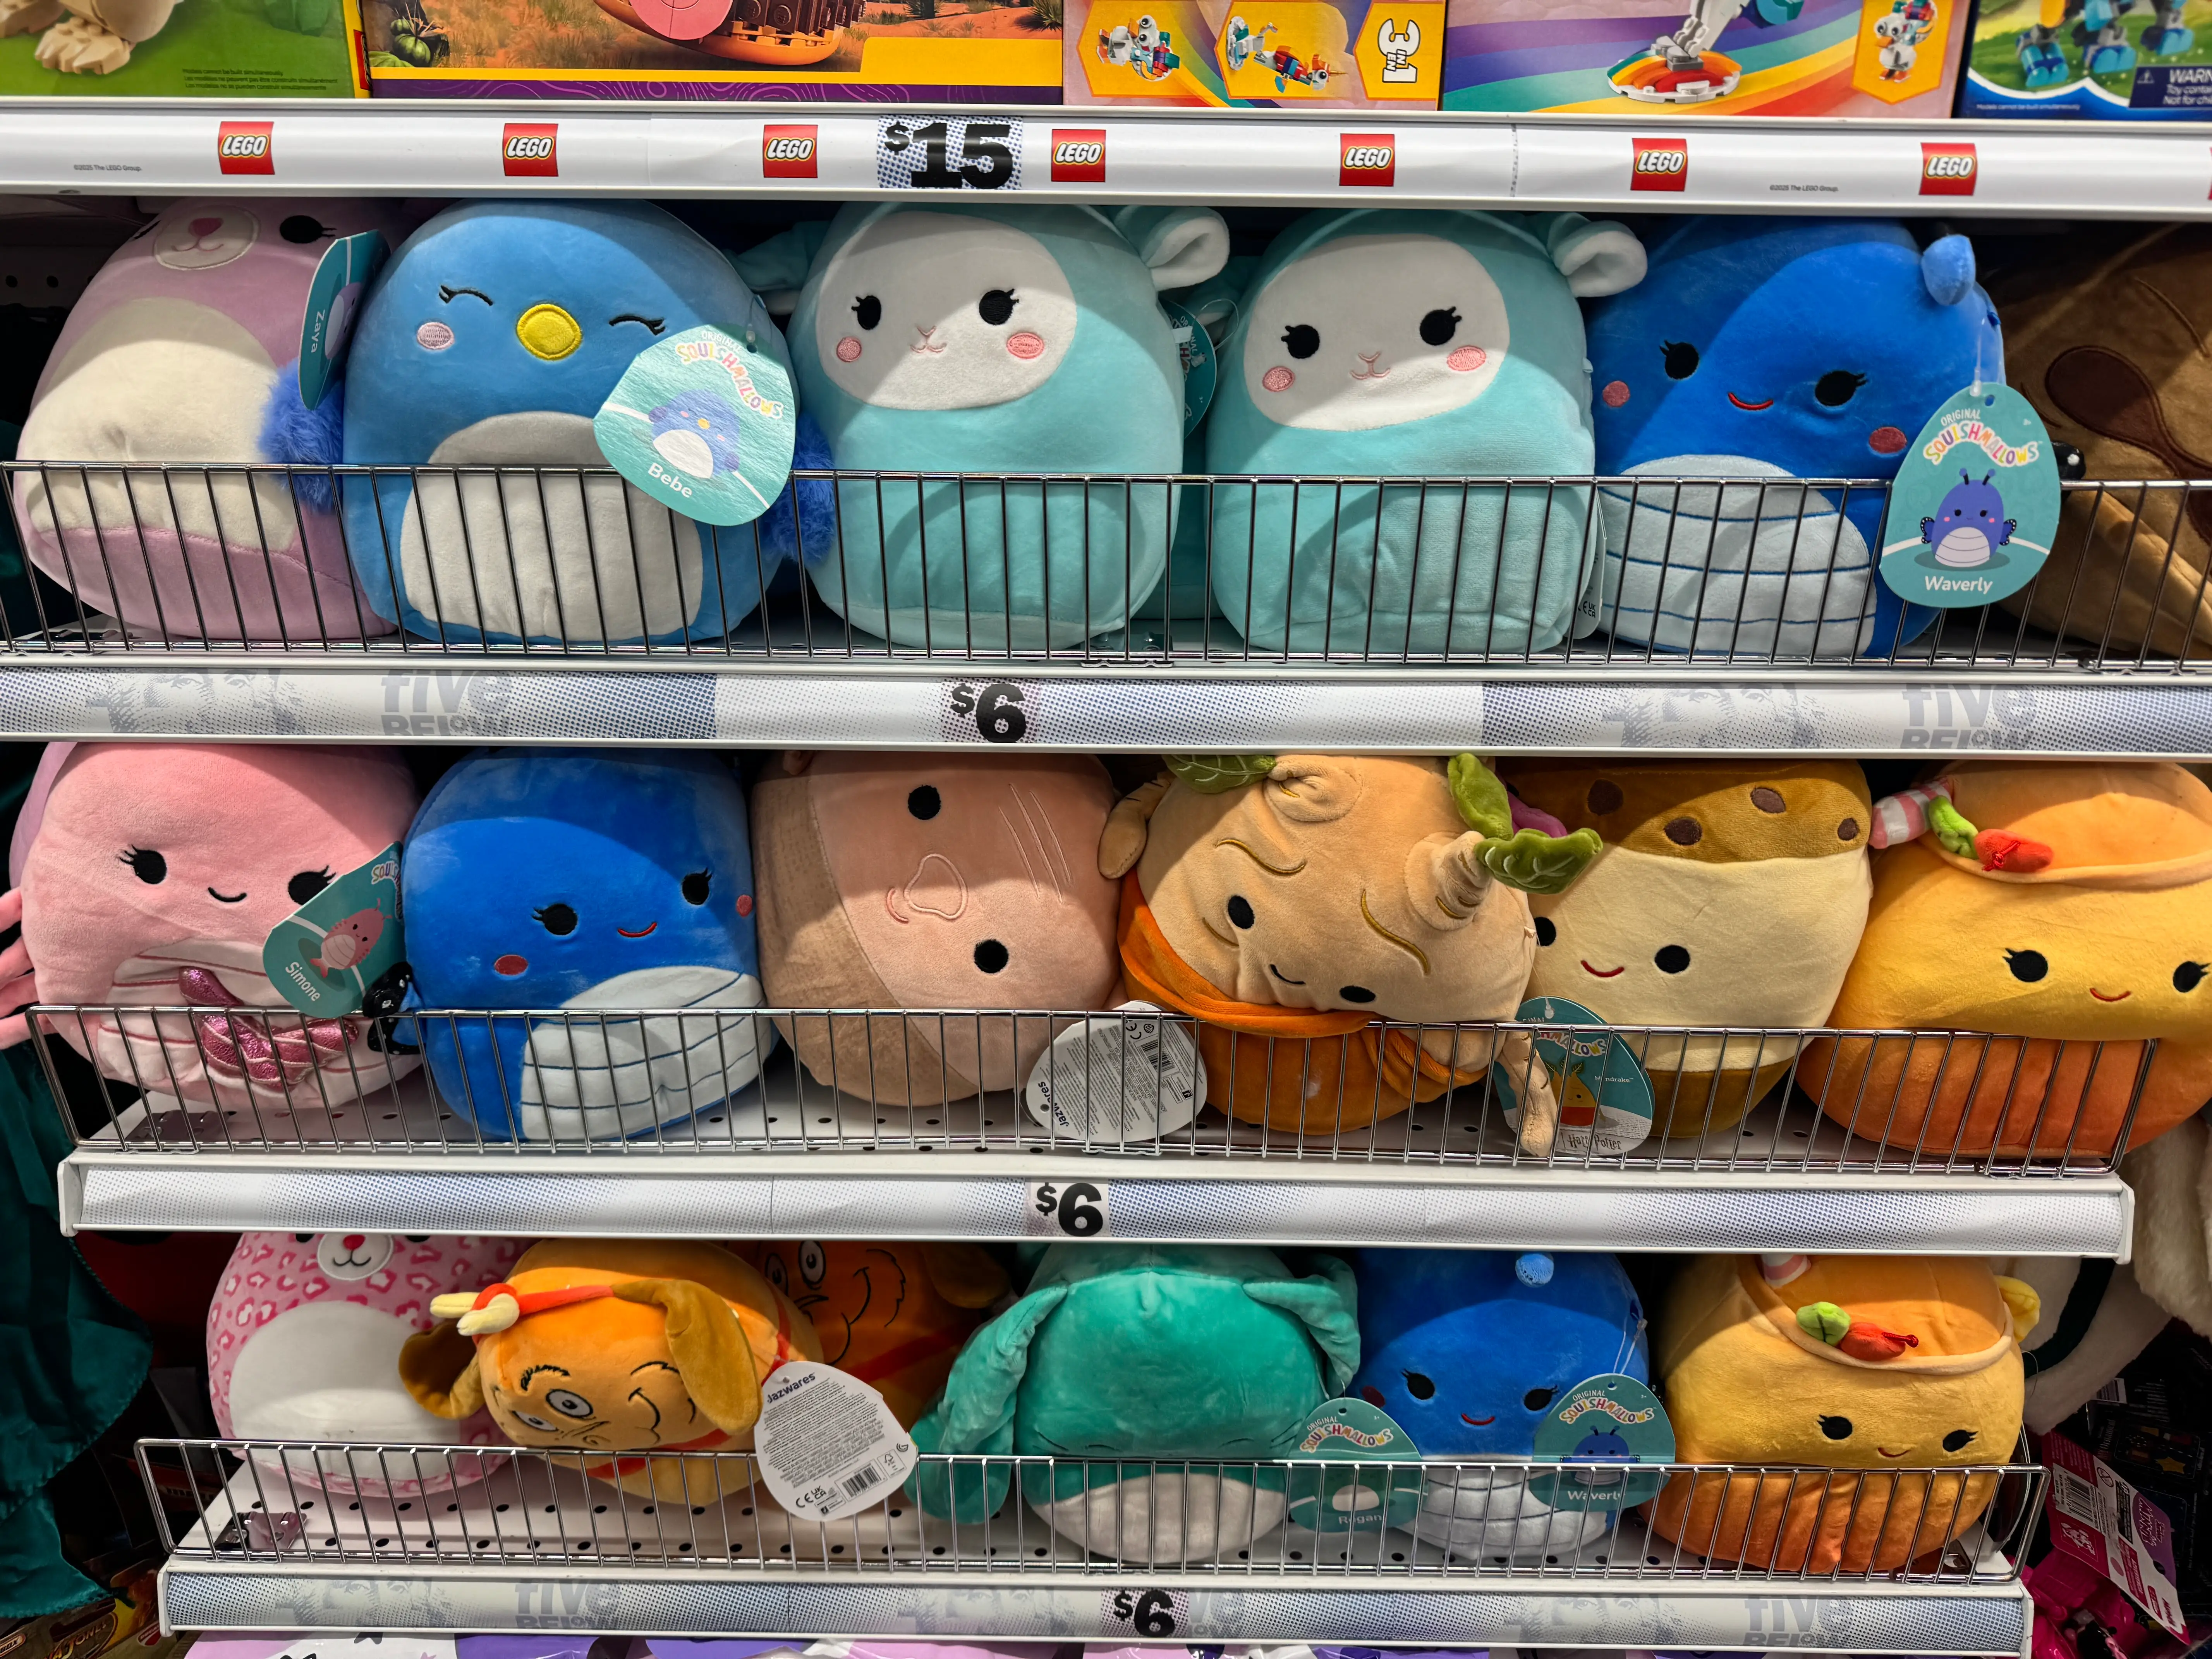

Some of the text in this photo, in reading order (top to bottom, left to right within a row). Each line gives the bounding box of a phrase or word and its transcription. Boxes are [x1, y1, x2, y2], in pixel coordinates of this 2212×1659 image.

[220, 134, 268, 157] LEGO
[505, 135, 553, 159] LEGO
[767, 137, 815, 161] LEGO
[884, 122, 1012, 189] $15
[1053, 140, 1102, 164] LEGO
[1342, 146, 1393, 169] LEGO
[1636, 150, 1685, 173] LEGO
[1925, 155, 1974, 178] LEGO
[311, 310, 325, 353] Zaya
[701, 330, 743, 352] ORIGINAL
[675, 342, 783, 419] SQUISHMALLOWS
[1941, 408, 1981, 426] ORIGINAL
[1922, 421, 2040, 467] SQUISHMALLOWS
[647, 462, 692, 498] Bebe
[1925, 575, 1993, 594] Waverly
[950, 683, 1026, 743] $6
[285, 962, 321, 1001] Simone
[1594, 1135, 1622, 1151] Potter
[1036, 1182, 1103, 1237] $6
[767, 1373, 816, 1404] Jazwares
[1573, 1390, 1605, 1400] ORIGINAL
[1559, 1397, 1655, 1424] SQUISHMALLOWS
[1307, 1416, 1338, 1431] ORIGINAL
[1300, 1423, 1394, 1453] SQUISHMALLOWS
[1114, 1590, 1175, 1637] $6
